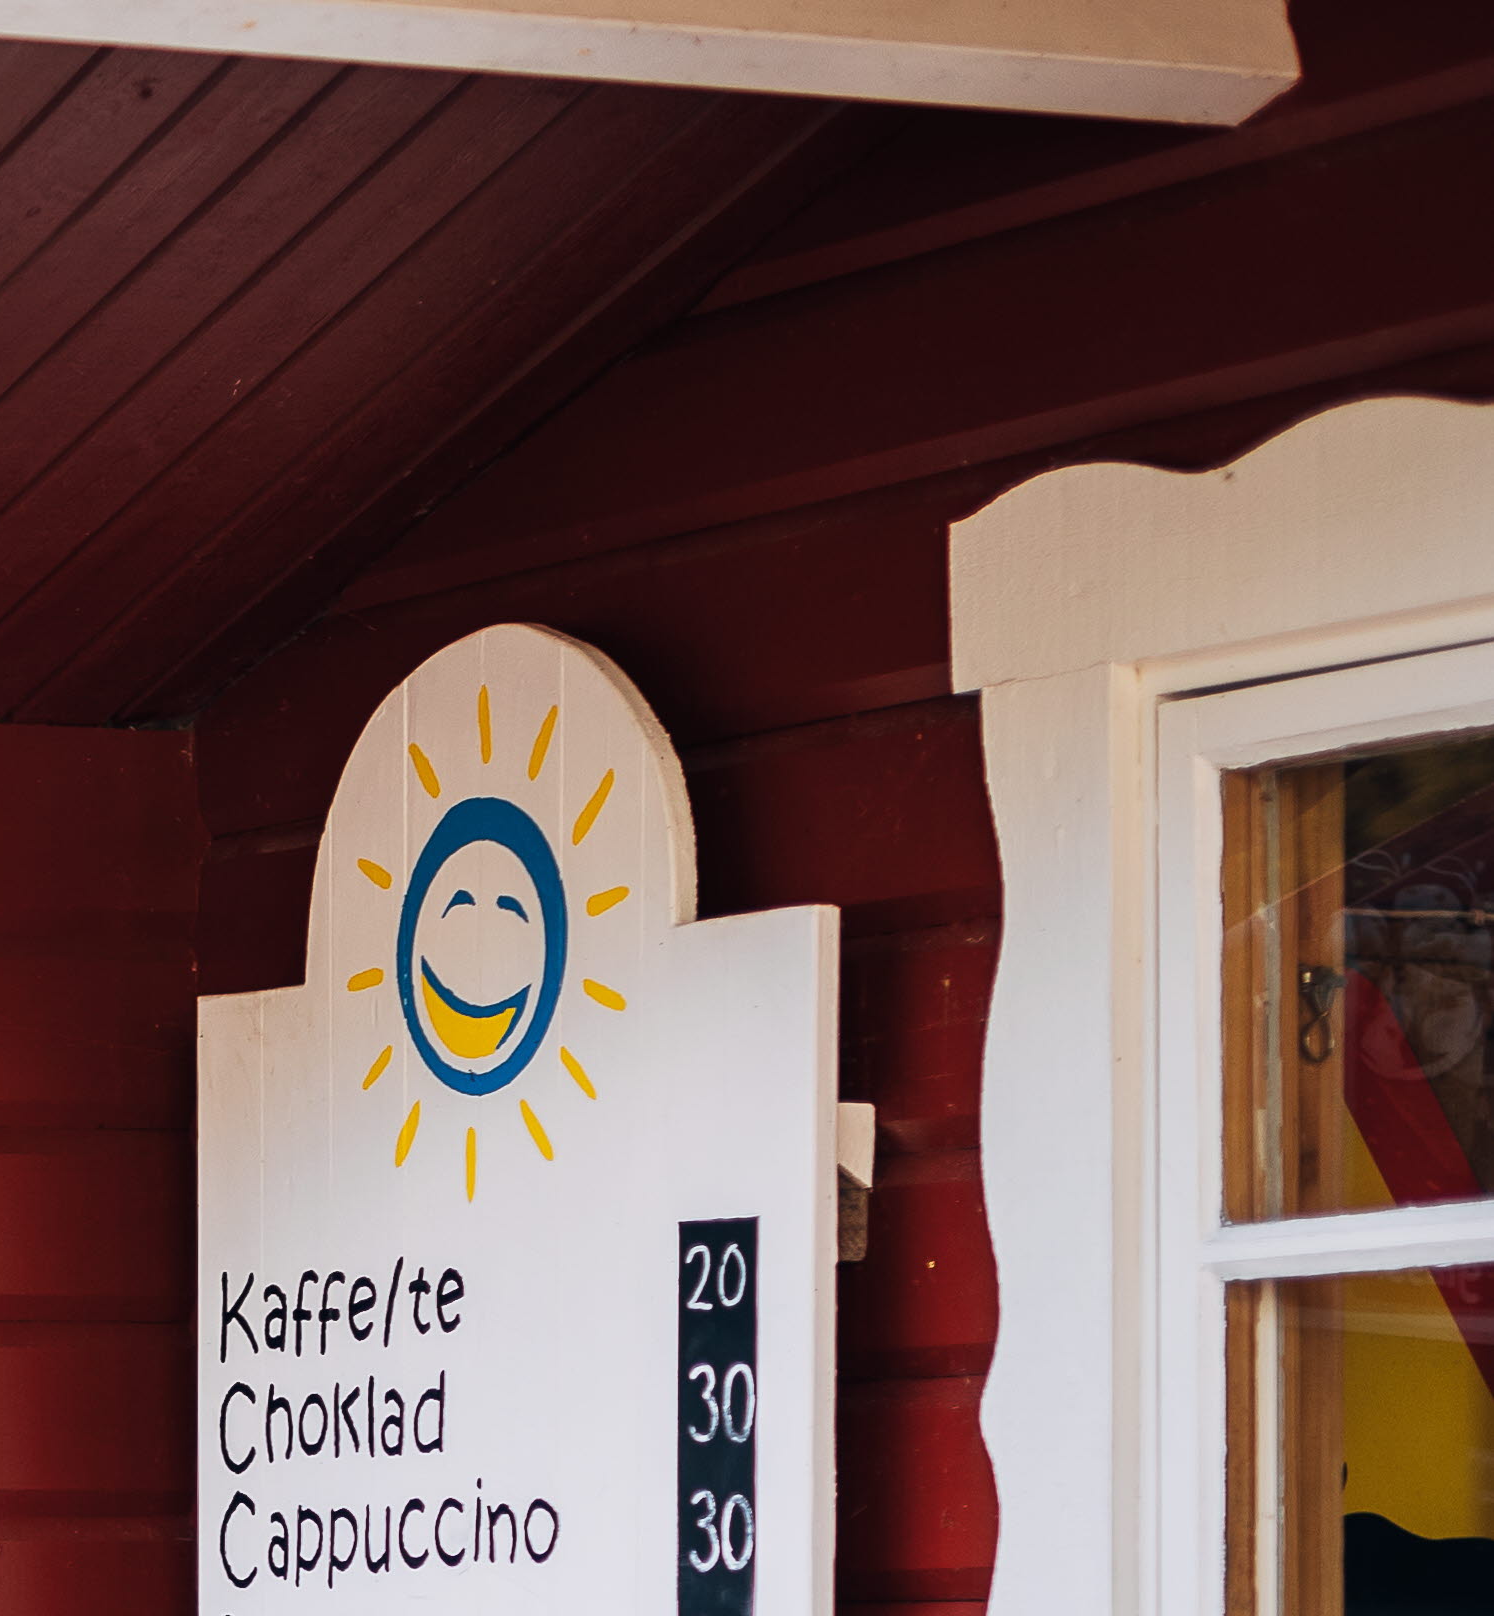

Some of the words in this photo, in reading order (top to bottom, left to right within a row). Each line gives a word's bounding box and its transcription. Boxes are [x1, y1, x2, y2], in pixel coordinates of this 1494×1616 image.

[220, 1256, 465, 1363] Kaffe/te
[684, 1243, 746, 1310] 20
[219, 1370, 445, 1473] Choklad
[688, 1363, 755, 1442] 30
[219, 1478, 560, 1588] Cappuccino
[688, 1490, 754, 1572] 30
